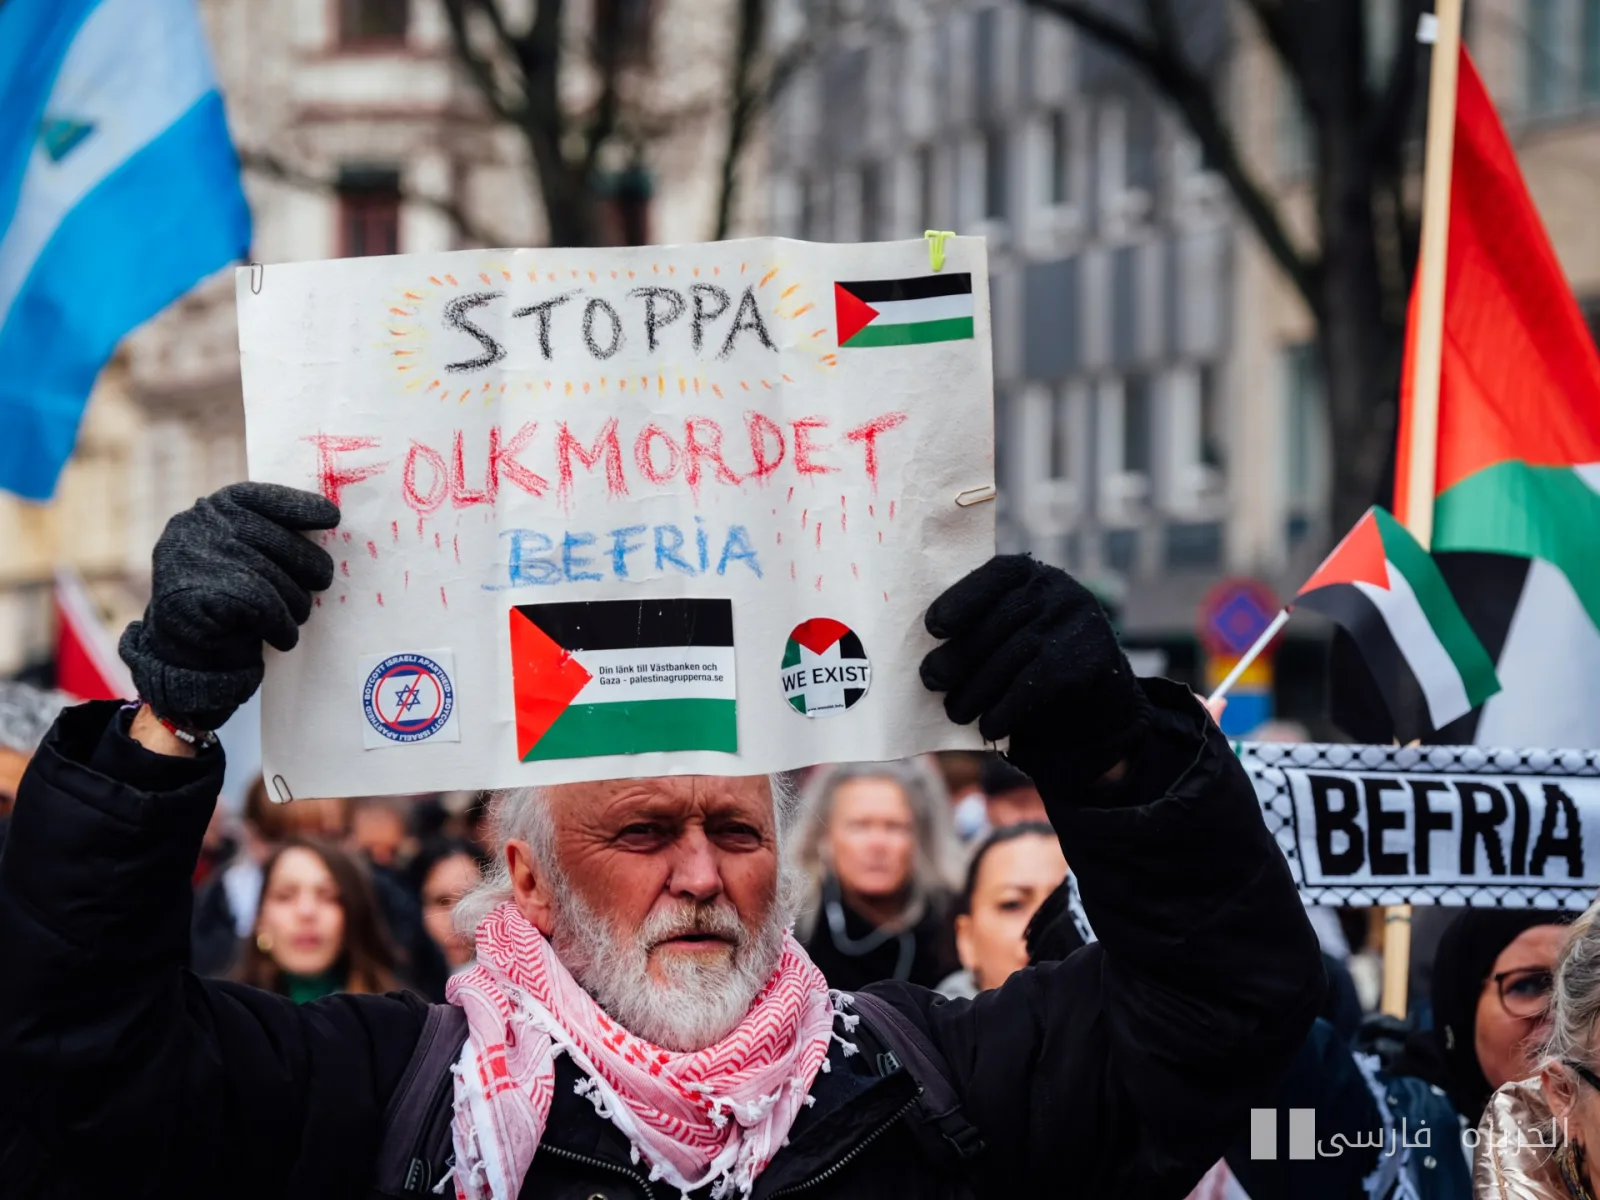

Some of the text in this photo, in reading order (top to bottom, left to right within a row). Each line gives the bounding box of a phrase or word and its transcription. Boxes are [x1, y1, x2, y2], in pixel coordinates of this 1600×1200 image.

[443, 284, 778, 373] STOPPA
[303, 410, 906, 516] FOLKMORDET
[364, 655, 451, 699] BOYCOTT ISRAELI APARTHEID
[599, 662, 718, 675] Din länk till Västbanken och
[599, 676, 621, 685] Gaza
[629, 674, 724, 685] palestinagrupperna.se
[782, 666, 868, 692] WE EXIST
[365, 697, 452, 741] BOYCOTT ISRAELI APARTHEID
[1308, 775, 1584, 877] BEFRIA
